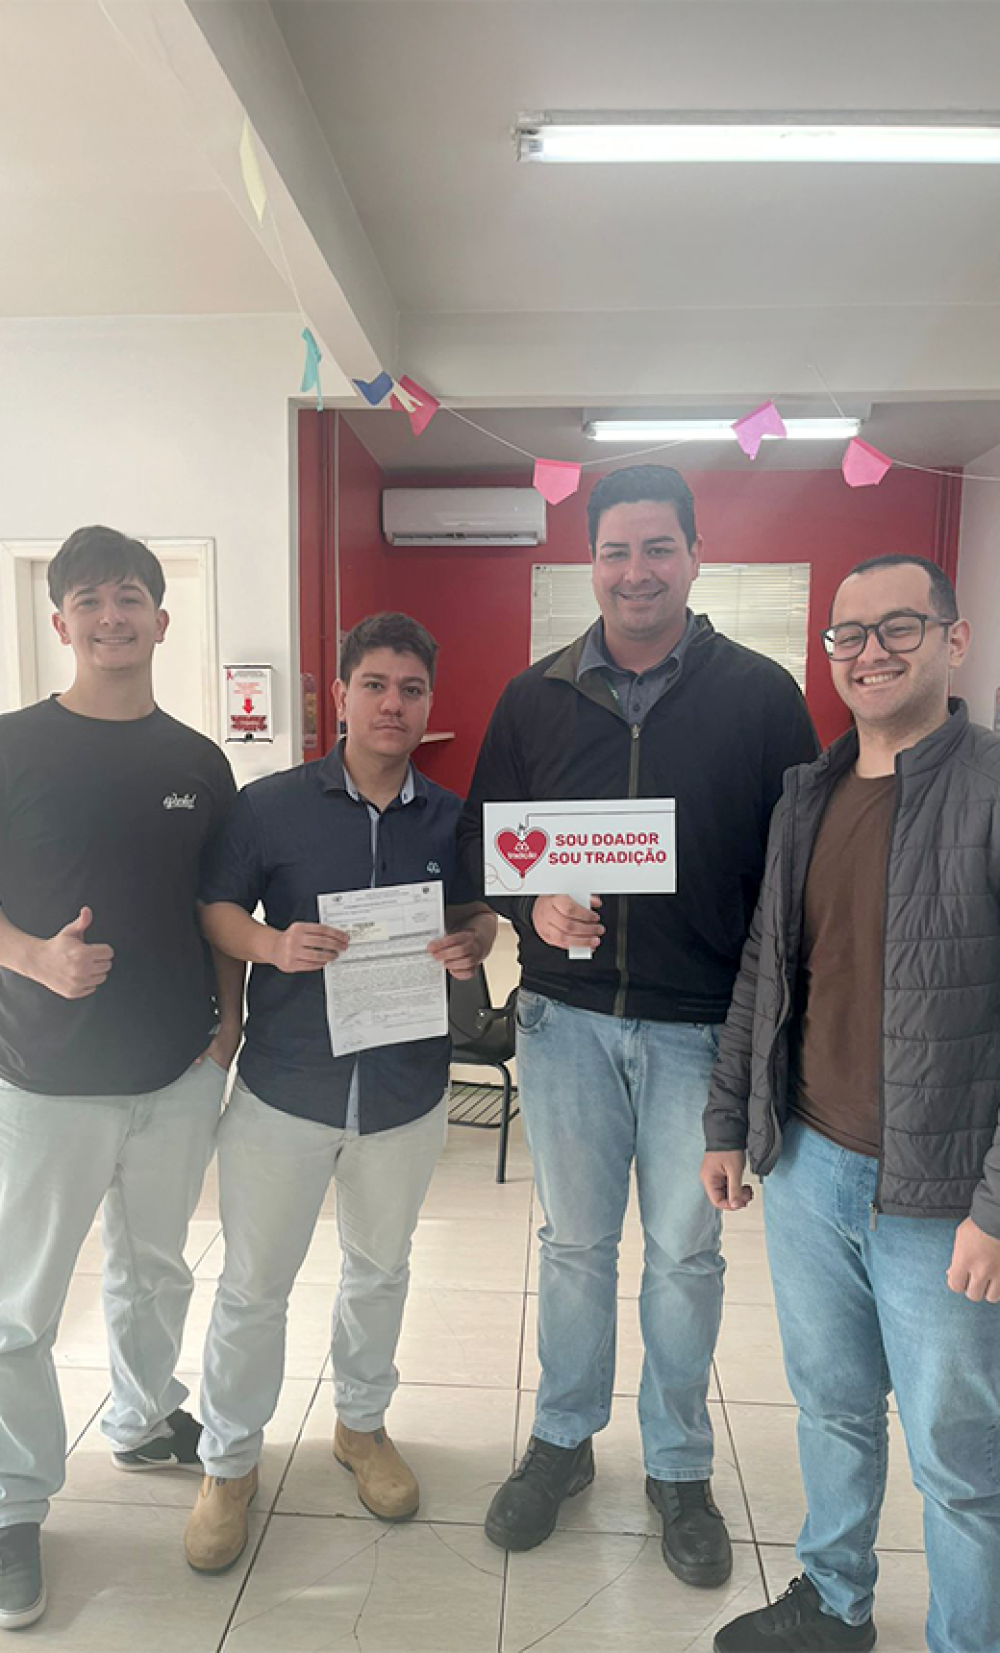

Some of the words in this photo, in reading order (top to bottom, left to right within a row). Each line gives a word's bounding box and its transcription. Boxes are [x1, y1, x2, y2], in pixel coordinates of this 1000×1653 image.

[555, 833, 588, 847] SOU
[591, 832, 659, 846] DOADOR
[549, 851, 581, 865] SOU
[584, 847, 667, 867] TRADIÇÃO
